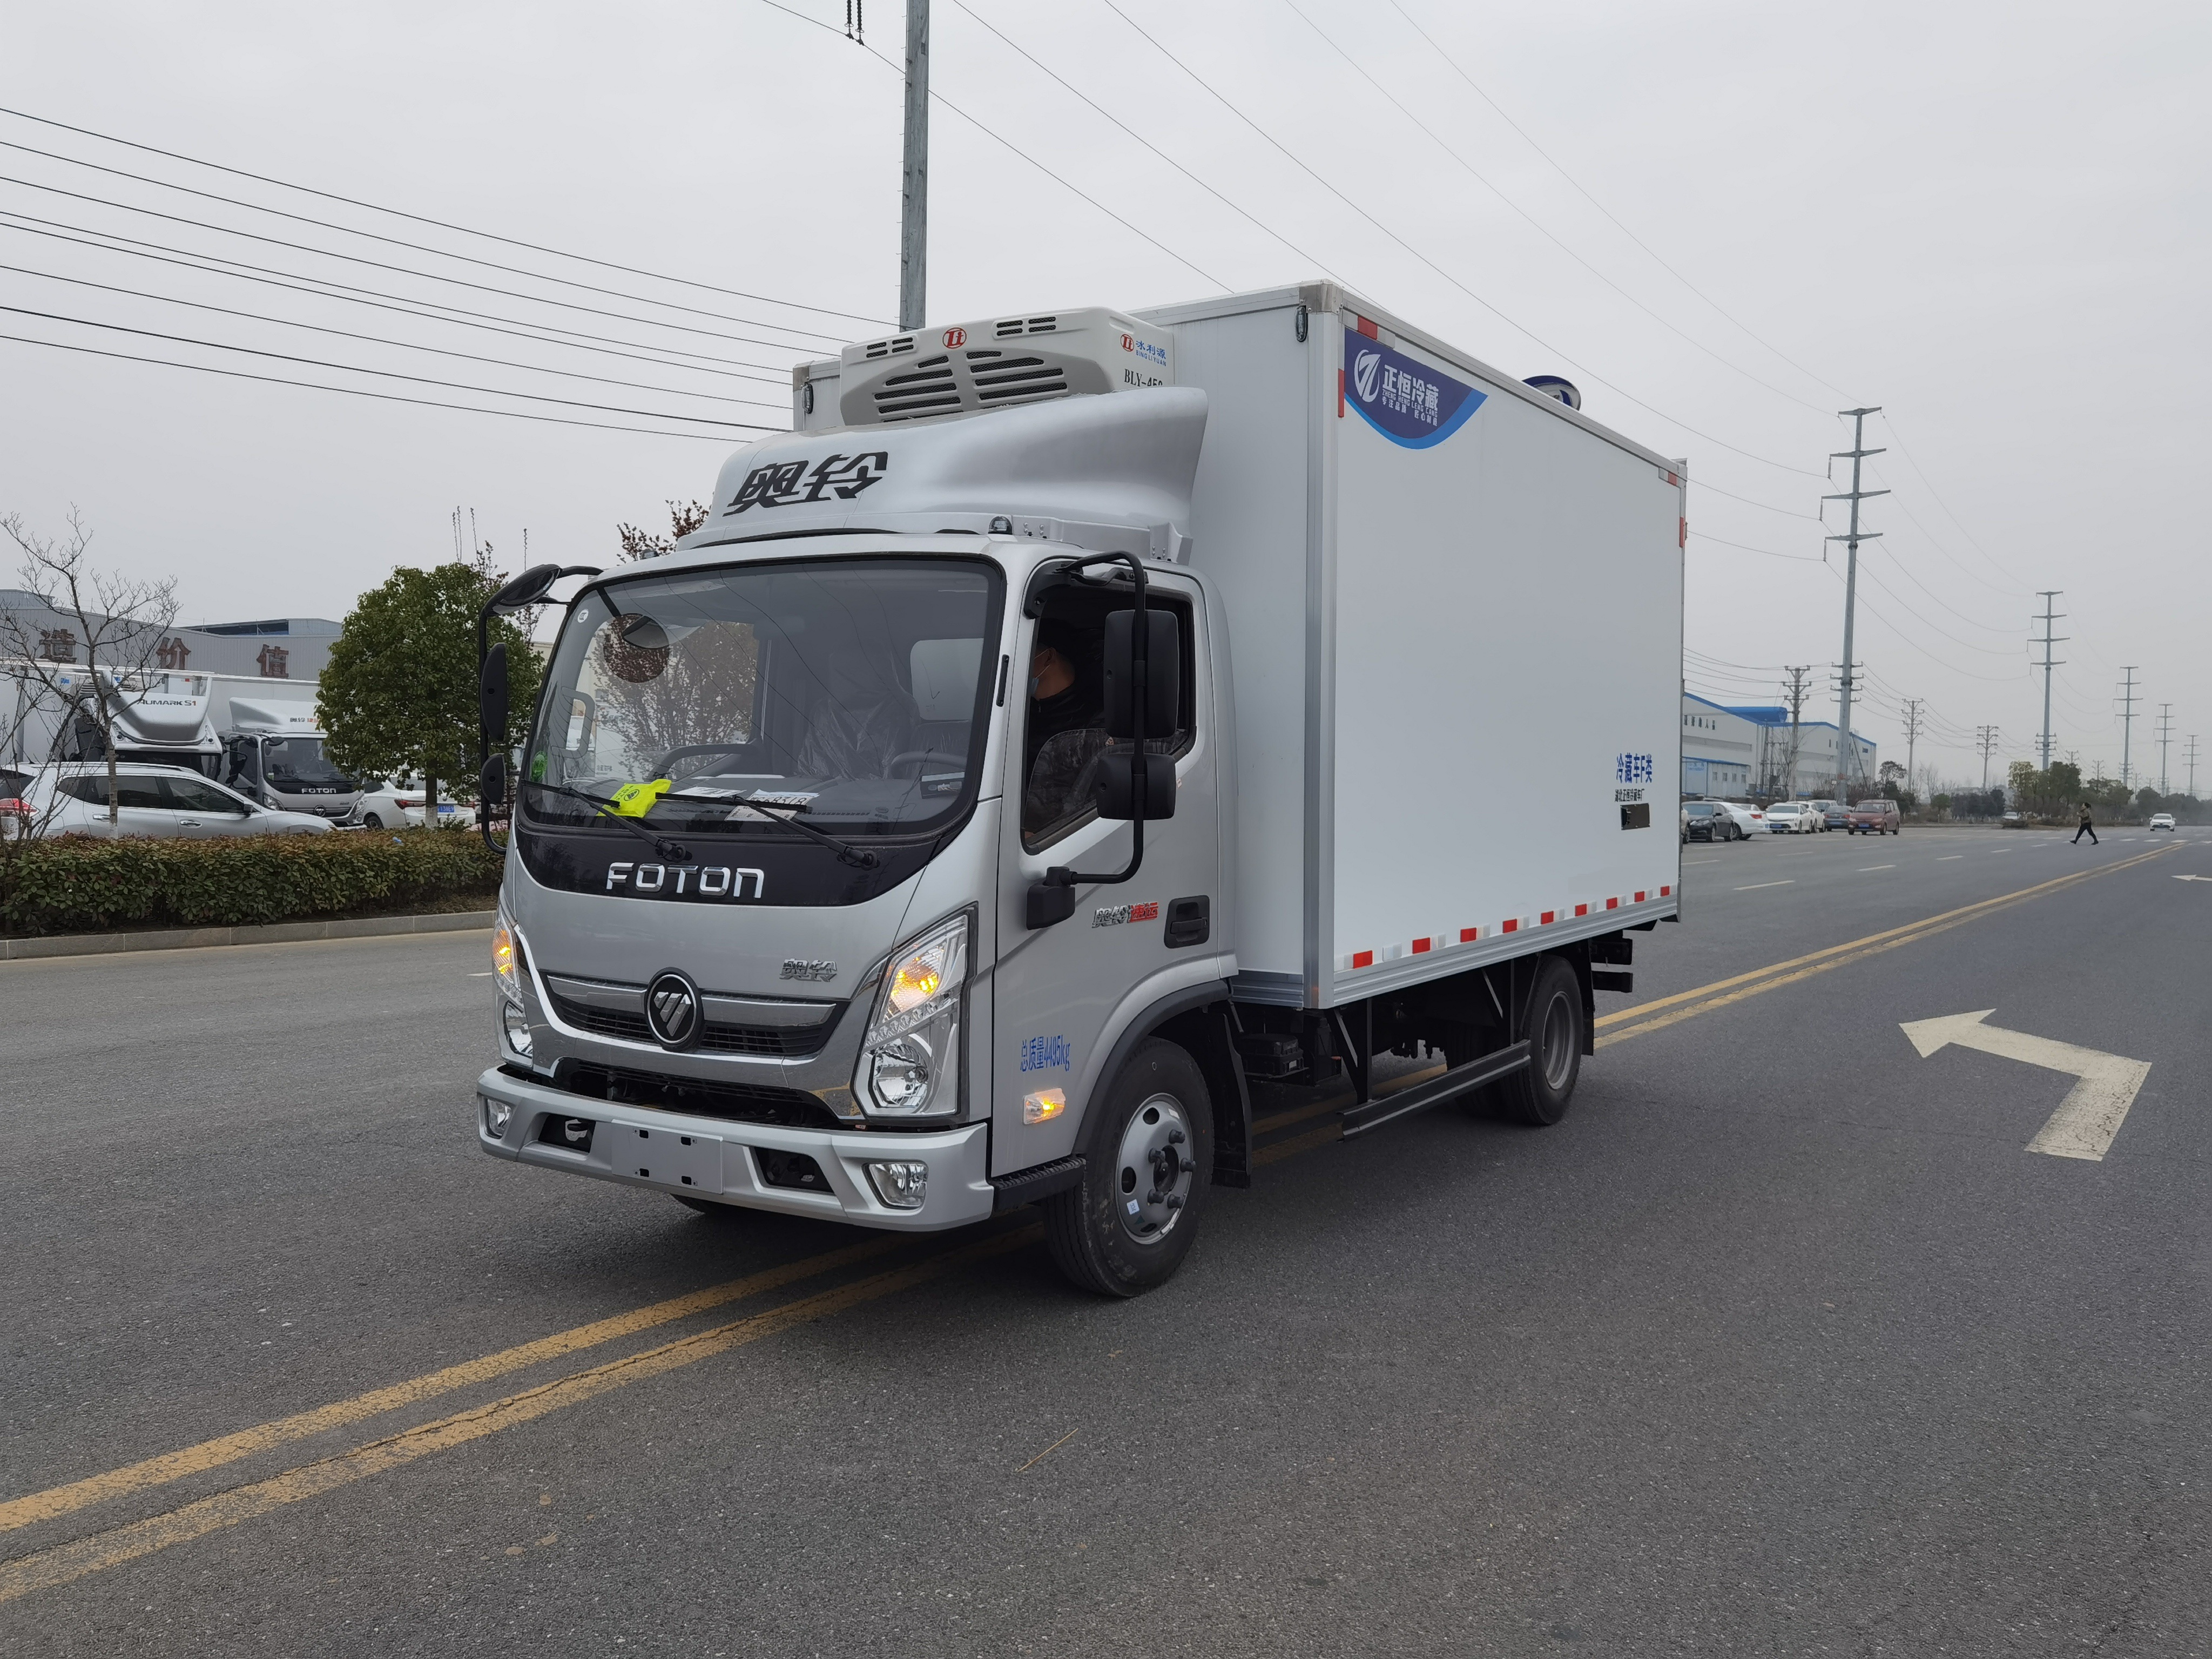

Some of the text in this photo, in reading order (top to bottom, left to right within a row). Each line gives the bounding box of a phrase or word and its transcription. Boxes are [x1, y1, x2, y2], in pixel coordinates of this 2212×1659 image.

[1382, 364, 1439, 412] 正恒冷藏
[1382, 389, 1438, 418] ZHENG HENG LENG CANG
[722, 451, 888, 517] 奥铃
[1616, 752, 1653, 784] 冷藏车F类
[605, 862, 765, 899] FOTON
[779, 958, 838, 982] 奥铃
[1020, 1034, 1070, 1072] 总质量4495kg
